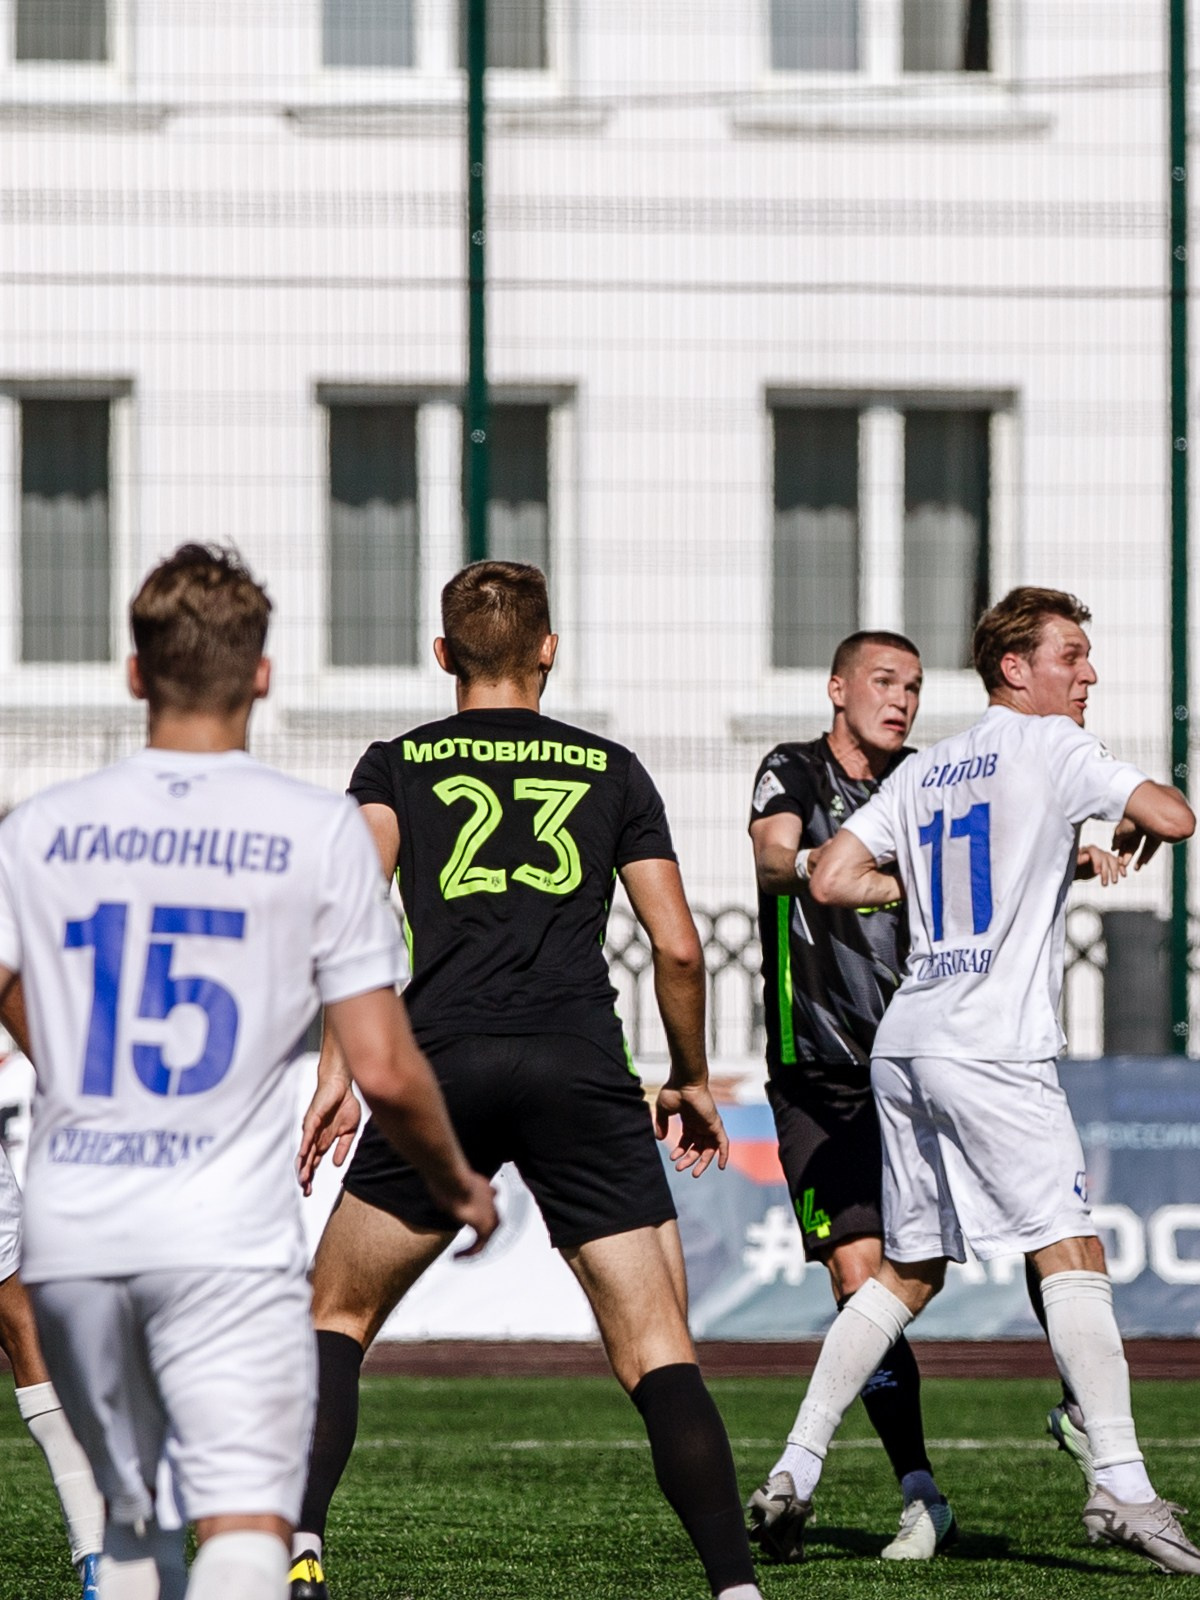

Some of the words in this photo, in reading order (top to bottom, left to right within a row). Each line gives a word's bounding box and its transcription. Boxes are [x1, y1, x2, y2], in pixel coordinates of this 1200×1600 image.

[402, 737, 608, 772] МОТОВИЛОВ
[45, 825, 292, 875] АГАФОНЦЕВ
[432, 774, 592, 901] 23
[918, 801, 994, 943] 11
[63, 901, 247, 1098] 15
